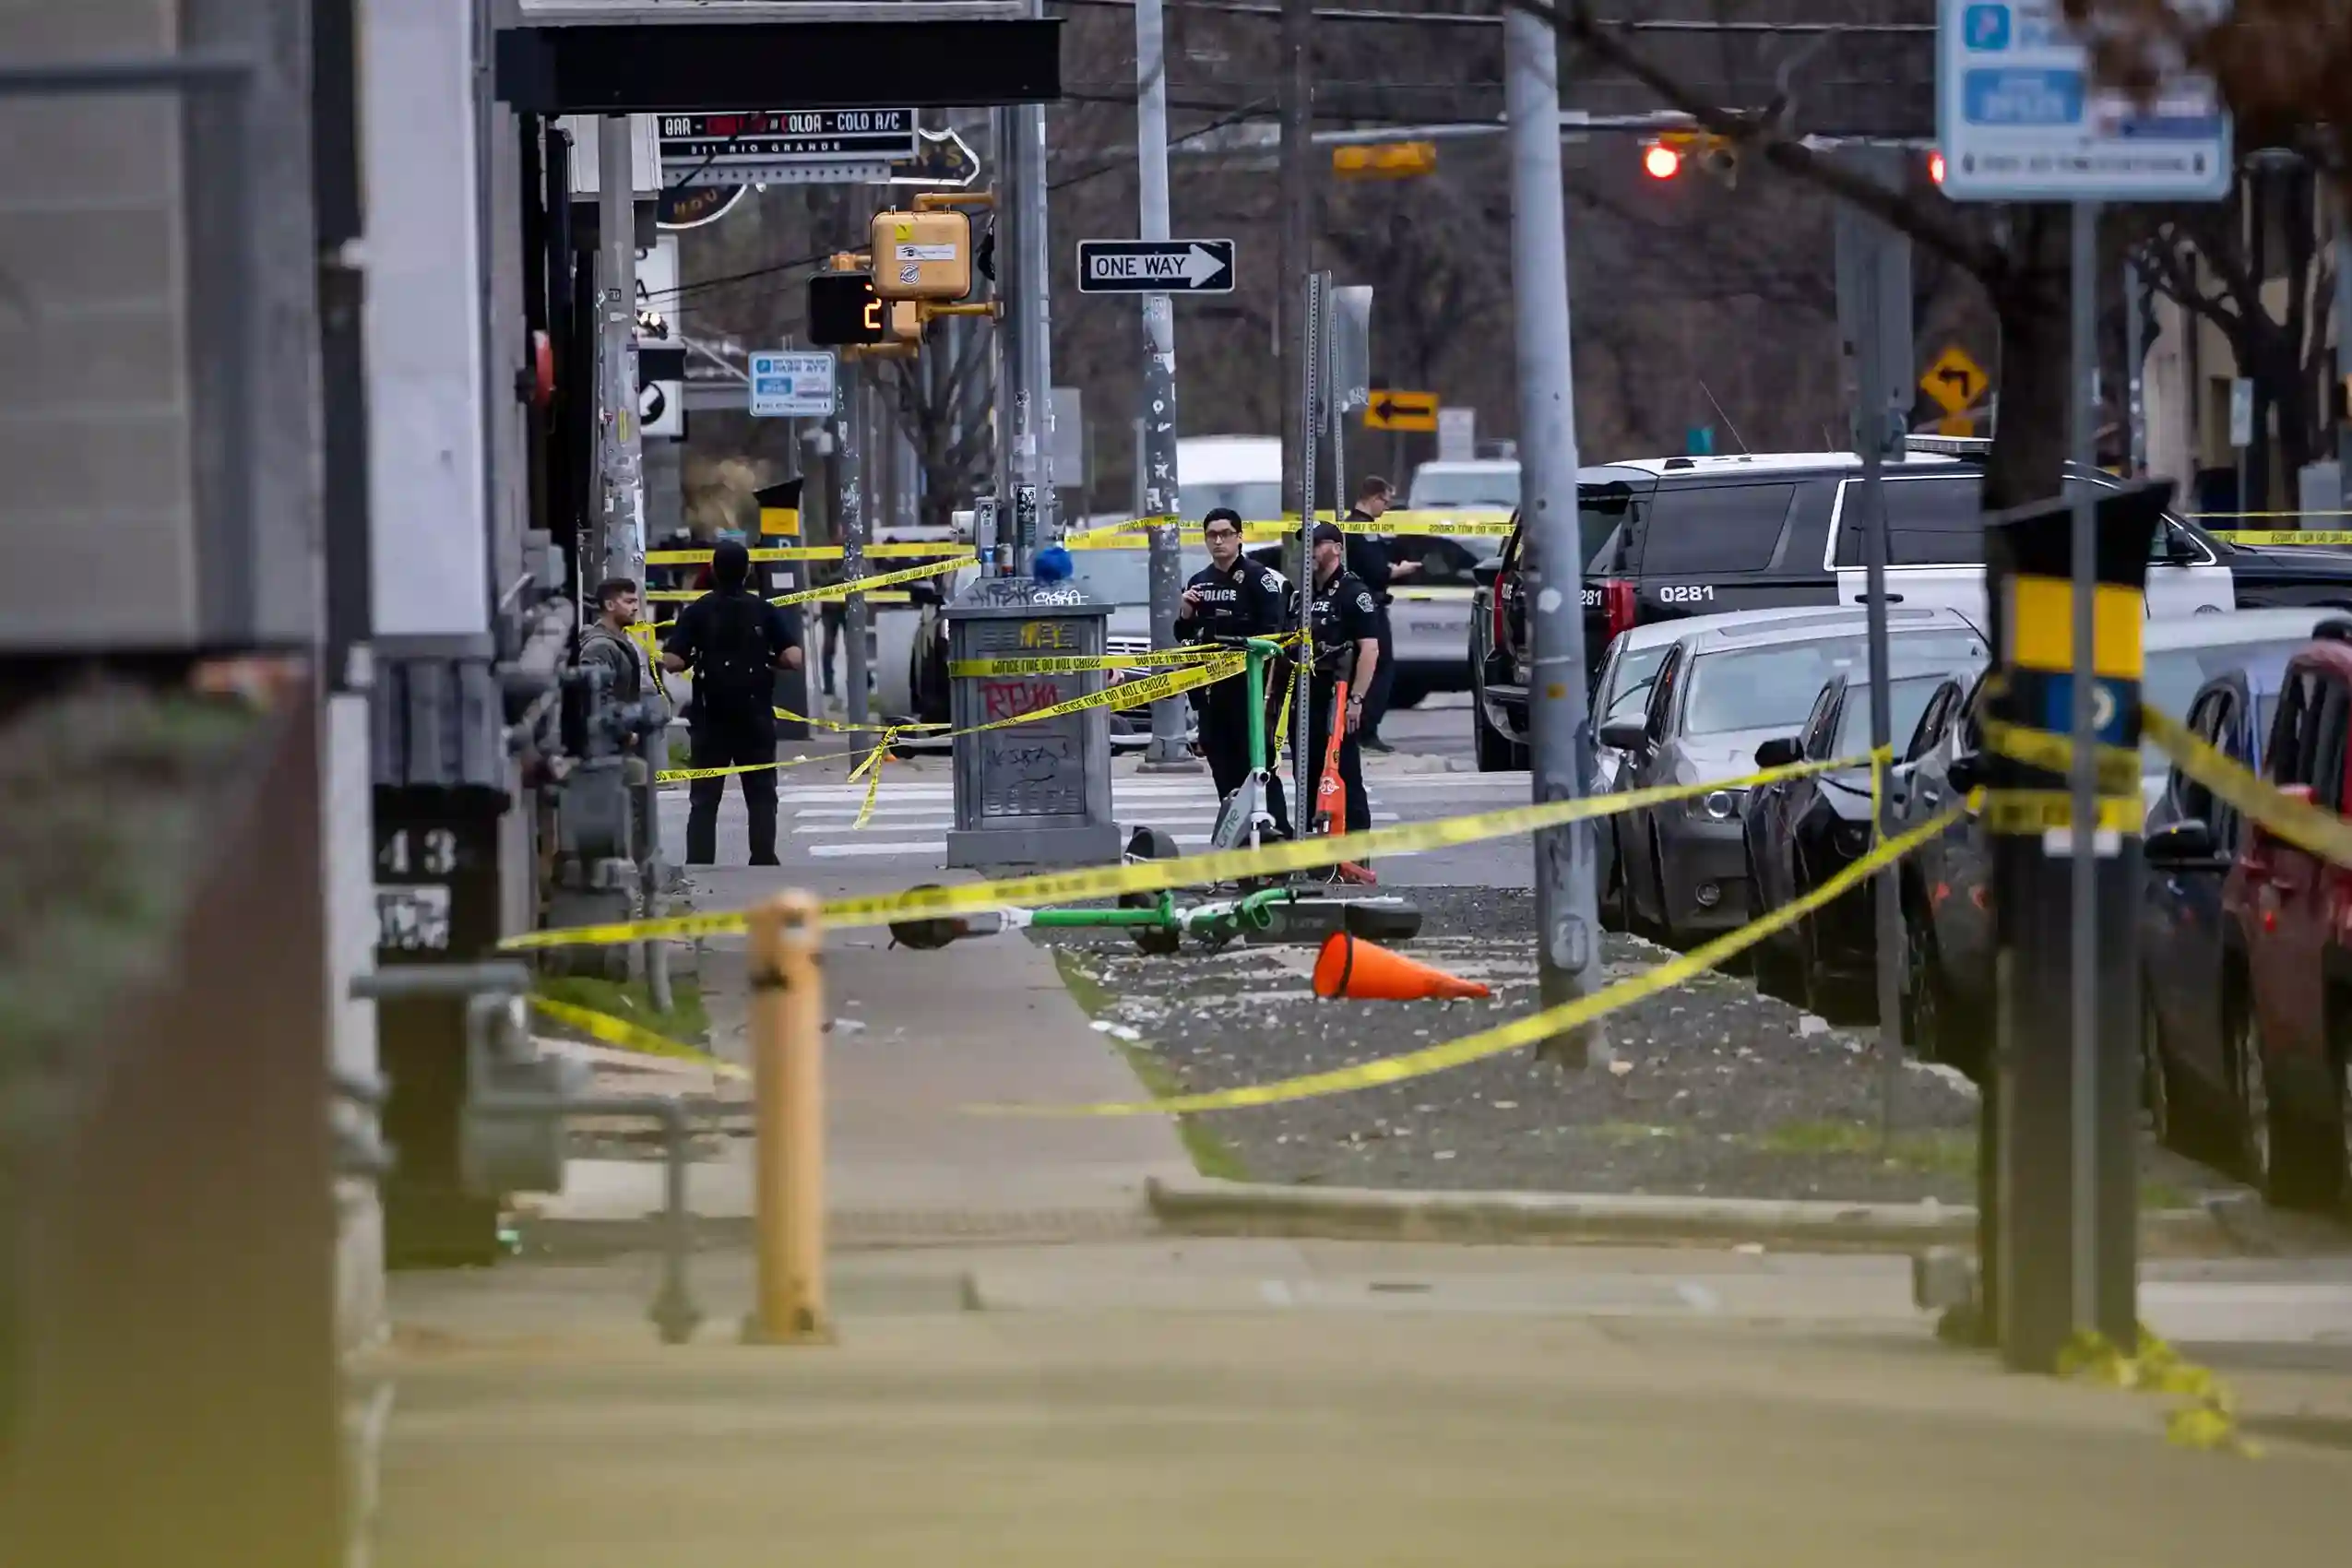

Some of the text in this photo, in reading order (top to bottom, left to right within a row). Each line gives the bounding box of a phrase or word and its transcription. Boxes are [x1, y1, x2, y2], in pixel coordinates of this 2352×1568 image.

[665, 117, 691, 137] BAR
[780, 113, 822, 133] COLOR
[837, 112, 870, 131] COLD
[874, 112, 900, 130] A/C
[771, 141, 840, 152] GRANDE
[1096, 256, 1187, 277] ONE WAY
[1580, 589, 1603, 606] 281
[1660, 585, 1715, 603] 0281
